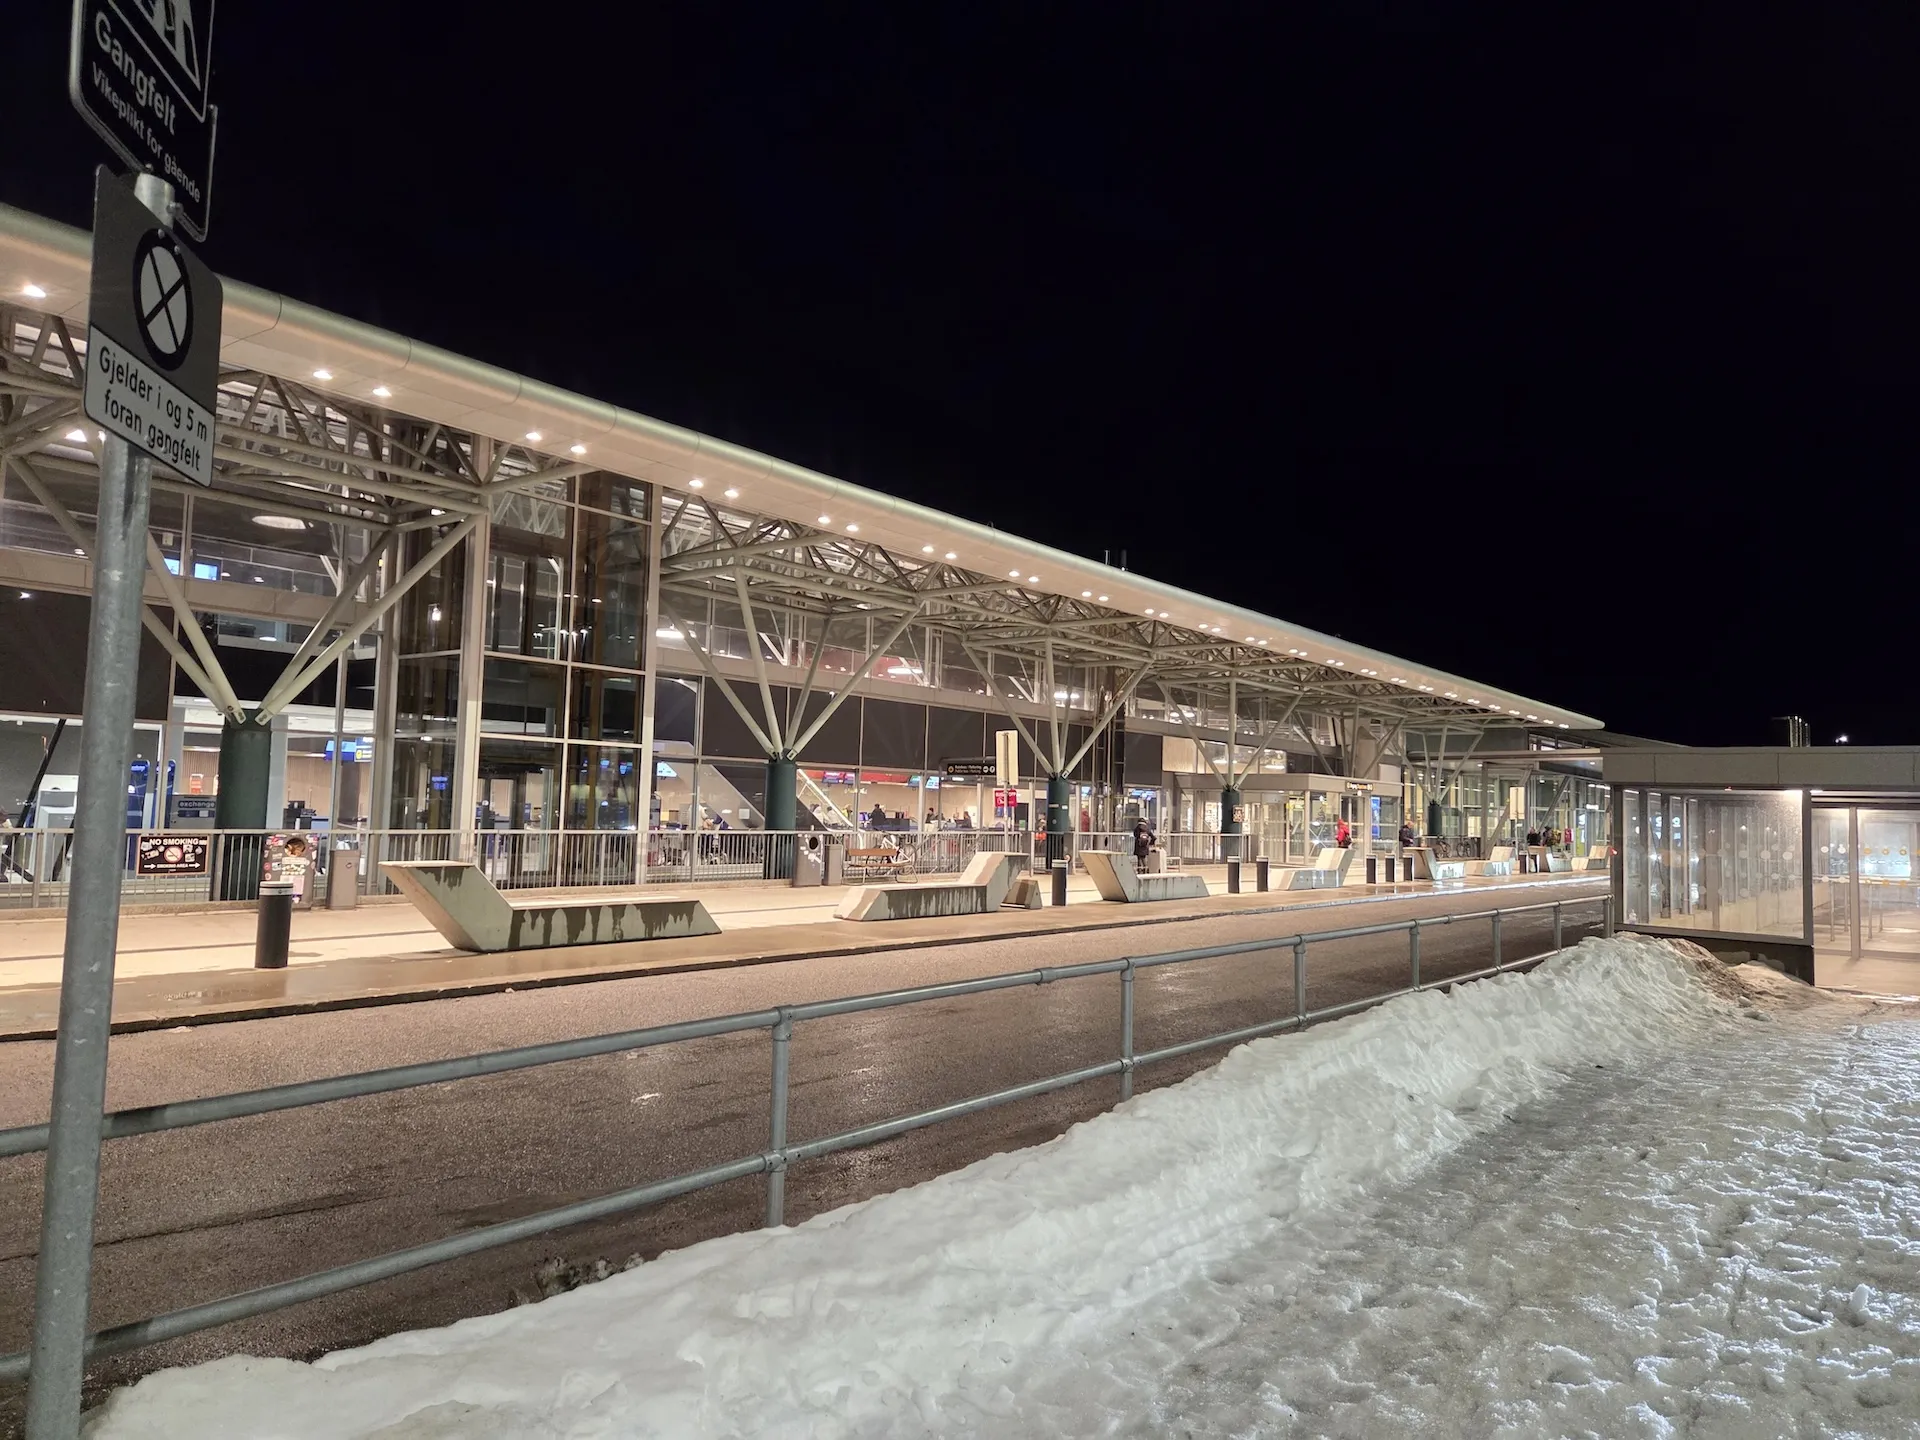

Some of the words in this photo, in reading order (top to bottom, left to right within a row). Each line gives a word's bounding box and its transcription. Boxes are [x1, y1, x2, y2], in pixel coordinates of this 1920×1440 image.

[95, 11, 176, 136] Gangfelt
[92, 61, 145, 139] Vikeplikt
[146, 127, 163, 159] for
[164, 153, 201, 203] gående
[99, 345, 153, 402] Gjelder
[156, 385, 161, 410] i
[166, 399, 182, 430] og
[186, 407, 195, 432] 5
[196, 421, 208, 442] m
[104, 389, 143, 435] foran
[147, 423, 201, 472] gangfelt
[149, 838, 162, 846] NO
[163, 838, 199, 846] SMOKING
[179, 800, 215, 809] exchange
